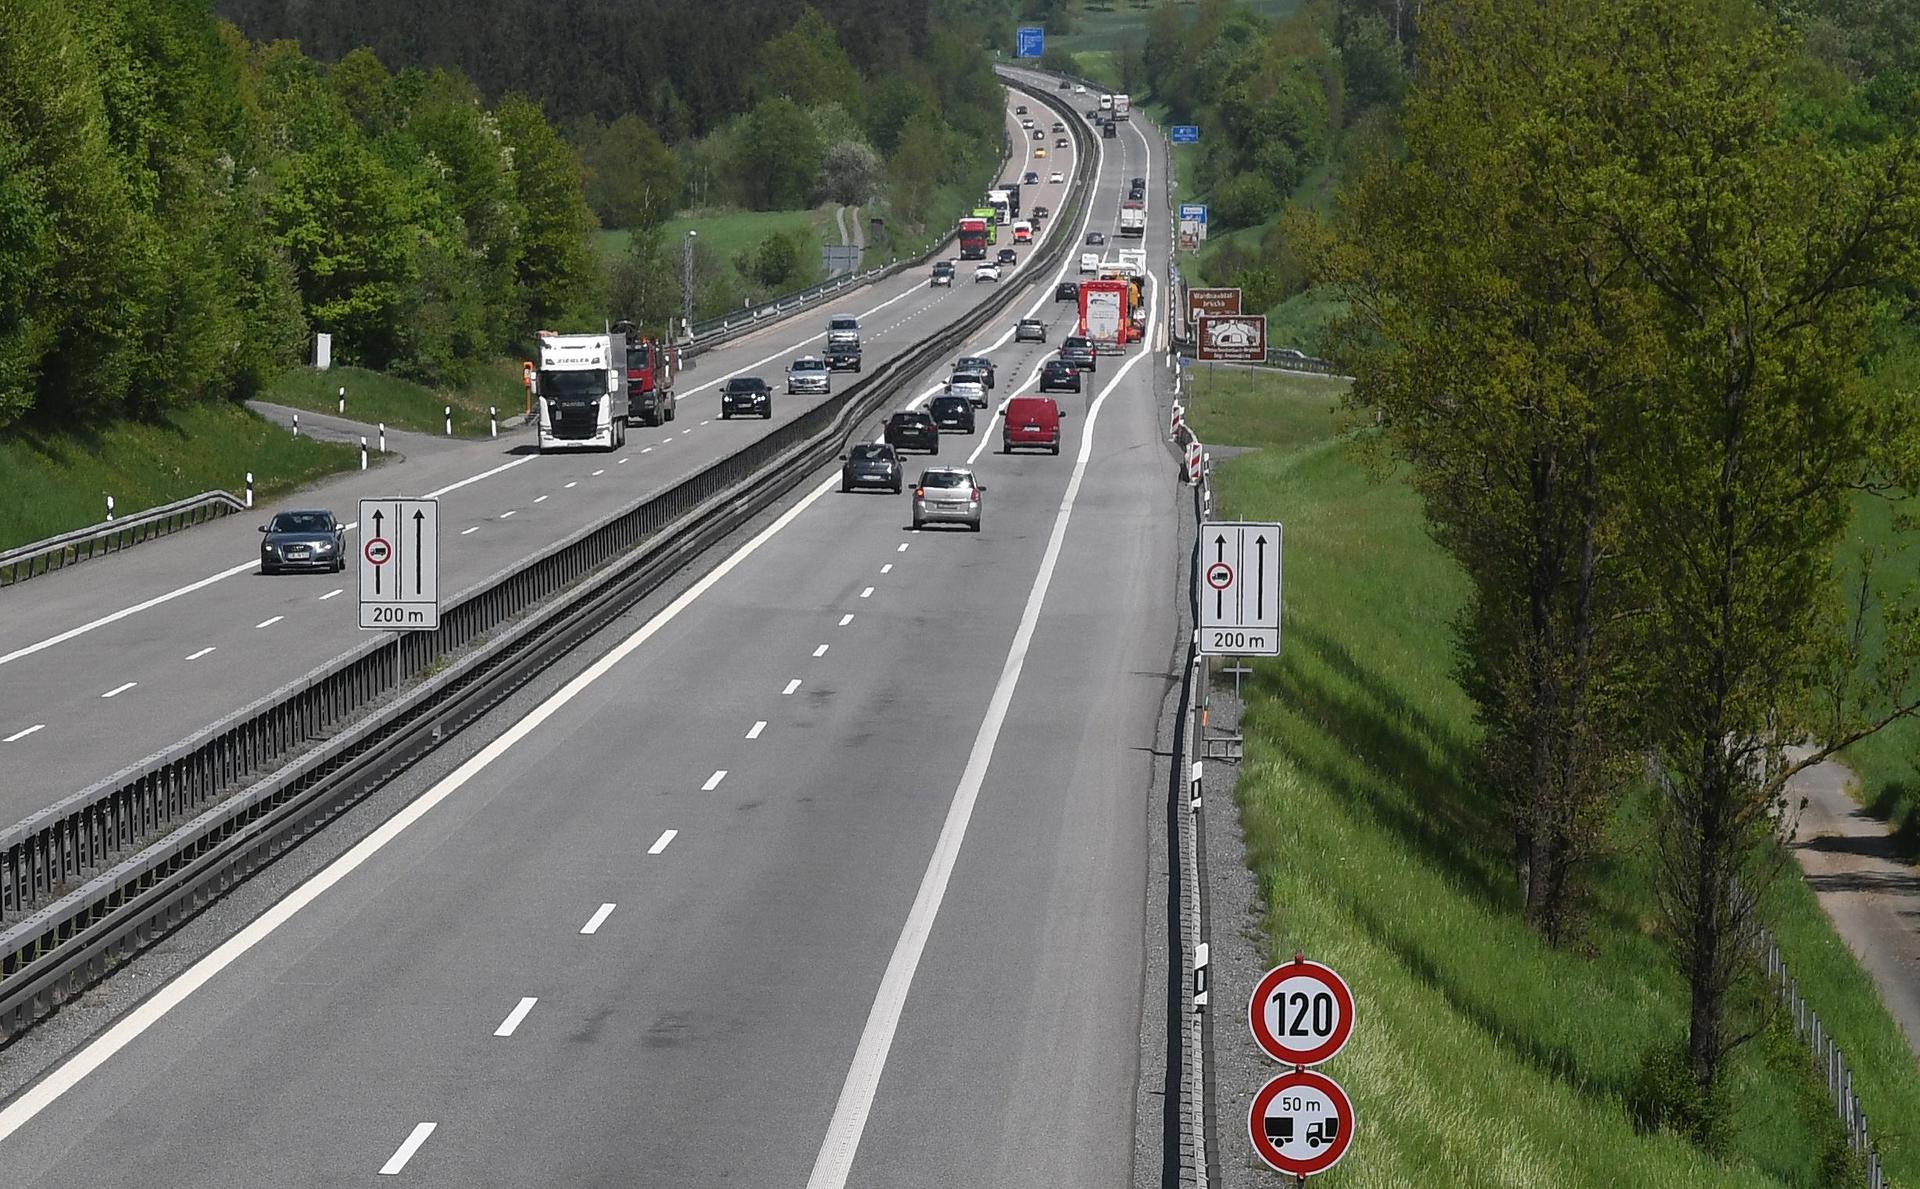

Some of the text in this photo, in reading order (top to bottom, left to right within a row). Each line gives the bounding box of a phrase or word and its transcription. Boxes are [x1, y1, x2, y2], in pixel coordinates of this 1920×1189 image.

[373, 608, 424, 623] 200 m
[1214, 632, 1265, 648] 200 m
[1272, 992, 1332, 1037] 120
[1282, 1097, 1321, 1112] 50 m
